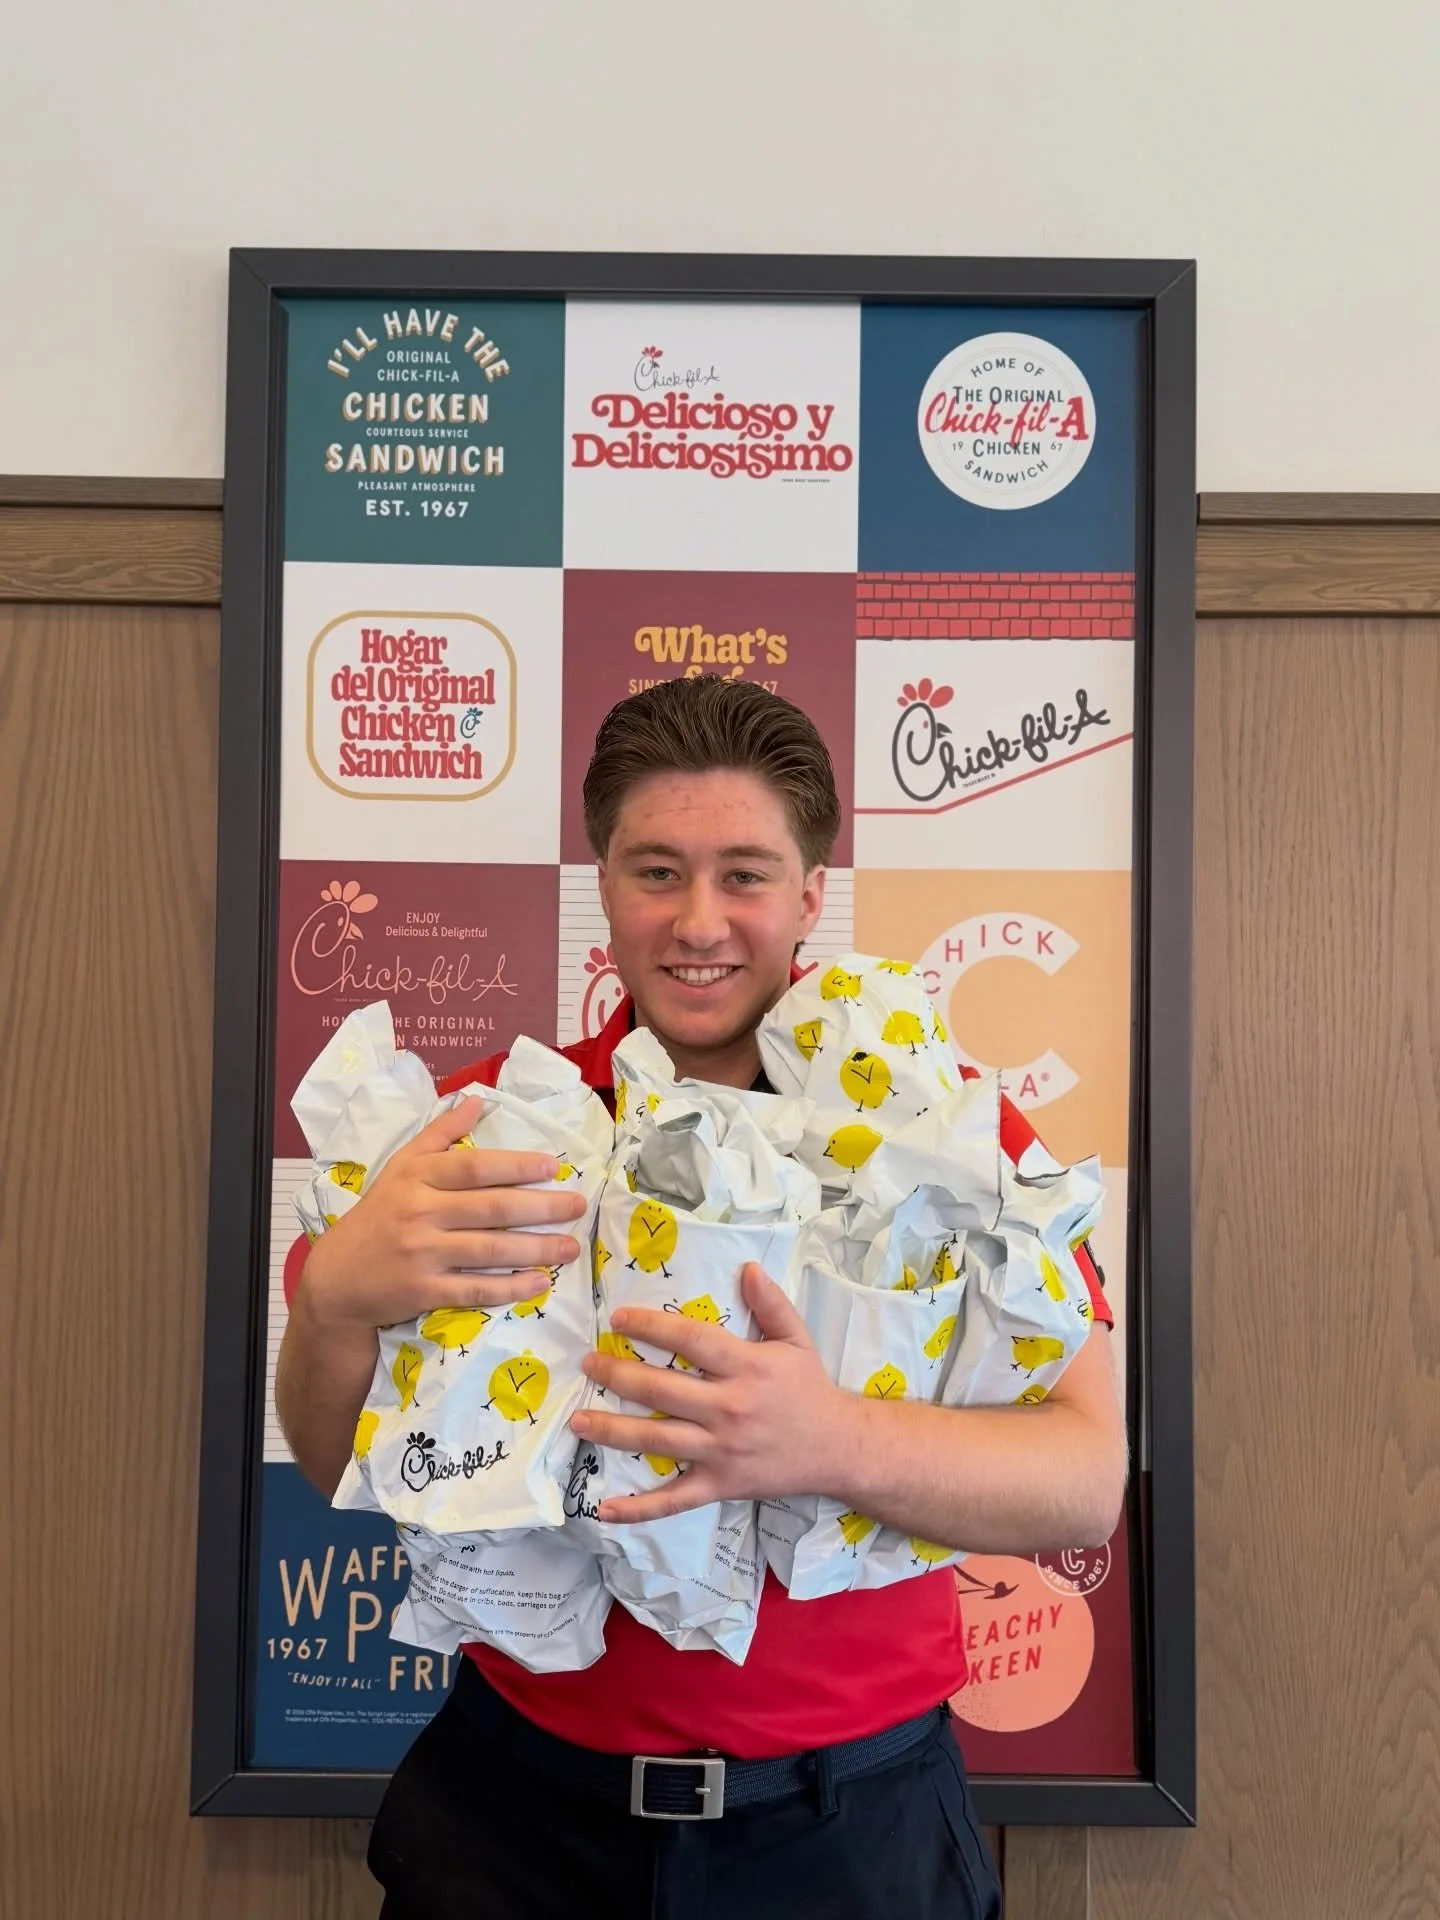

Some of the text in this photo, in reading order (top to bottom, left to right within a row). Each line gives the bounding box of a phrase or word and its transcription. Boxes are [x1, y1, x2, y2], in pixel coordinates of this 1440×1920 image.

[328, 308, 510, 383] I'LL HAVE THE
[387, 350, 451, 363] ORIGINAL
[377, 369, 460, 382] CHICK-FIL-A
[634, 354, 720, 391] Chick-fil-A
[971, 358, 1045, 378] HOME OF
[342, 391, 489, 424] CHICKEN
[953, 386, 1064, 405] THE ORIGINAL
[591, 392, 834, 441] Delicioso y
[924, 391, 1089, 449] Chick-fil-A
[366, 427, 469, 438] COURTEOUS SERVICE
[325, 443, 504, 476] SANDWICH
[571, 431, 853, 479] Deliciosísimo
[952, 438, 1063, 458] 19 CHICKEN 67
[964, 459, 1049, 484] SANDWICH
[358, 480, 476, 492] PLEASANT ATMOSPHERE
[366, 499, 469, 518] EST. 1967
[360, 629, 447, 673] Hogar
[634, 624, 788, 665] What's
[331, 665, 496, 712] del Original
[629, 679, 674, 694] SIN
[341, 704, 456, 742] Chicken
[892, 689, 1110, 802] Chick-fil-A
[339, 742, 482, 779] Sandwich
[406, 912, 441, 924] ENJOY
[385, 926, 488, 940] Delicious & Delightful
[291, 901, 519, 1005] Chick-fil-A
[322, 1015, 496, 1030] HO HE ORIGINAL
[439, 1555, 447, 1563] Do
[449, 1559, 459, 1568] not
[469, 1565, 482, 1574] with
[714, 1553, 731, 1568] beds,
[279, 1546, 408, 1627] WAFF
[1044, 1558, 1106, 1590] SINCE 1967
[439, 1587, 446, 1596] Do
[447, 1591, 457, 1599] not
[457, 1595, 468, 1603] use
[517, 1601, 547, 1610] carriages
[440, 1577, 449, 1586] the
[449, 1581, 469, 1592] danger
[479, 1588, 516, 1598] suffocation,
[518, 1589, 533, 1599] keep
[535, 1591, 547, 1599] this
[548, 1592, 561, 1601] bag
[514, 1630, 536, 1639] property
[966, 1603, 1064, 1651] EACHY
[267, 1638, 329, 1660] 1967
[390, 1655, 449, 1692] FRI
[969, 1644, 1043, 1686] KEEN
[335, 1677, 347, 1688] IT
